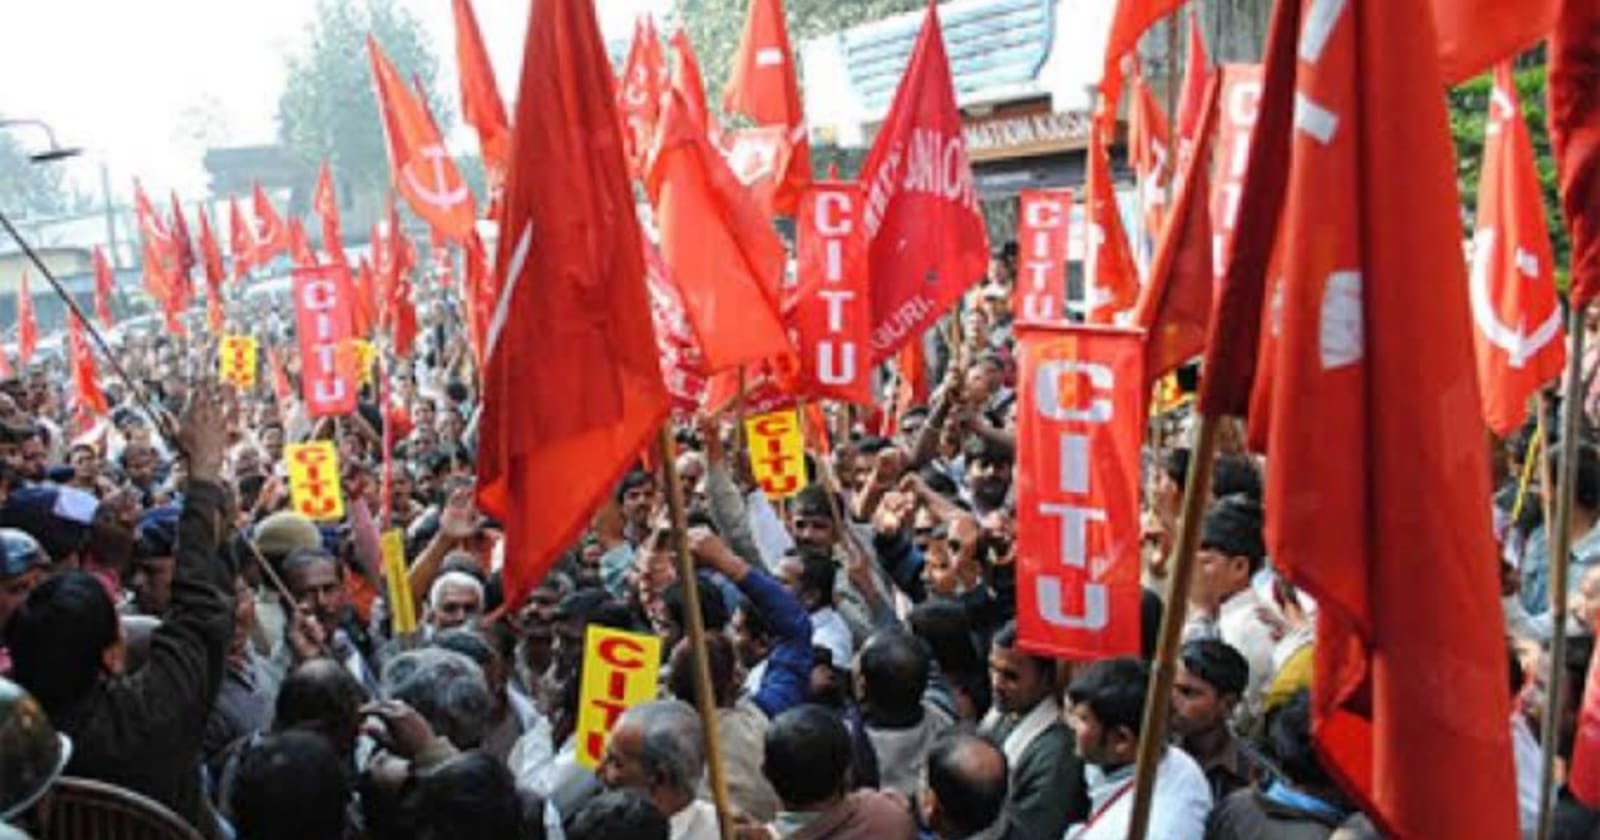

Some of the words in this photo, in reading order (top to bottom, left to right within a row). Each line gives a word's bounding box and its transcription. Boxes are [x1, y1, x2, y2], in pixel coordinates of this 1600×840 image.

[813, 190, 855, 384] CITU
[1023, 202, 1061, 323] CITU
[302, 279, 345, 402] CITU
[293, 446, 338, 518] CITU
[756, 417, 798, 493] CITU
[1034, 359, 1115, 631] CITU
